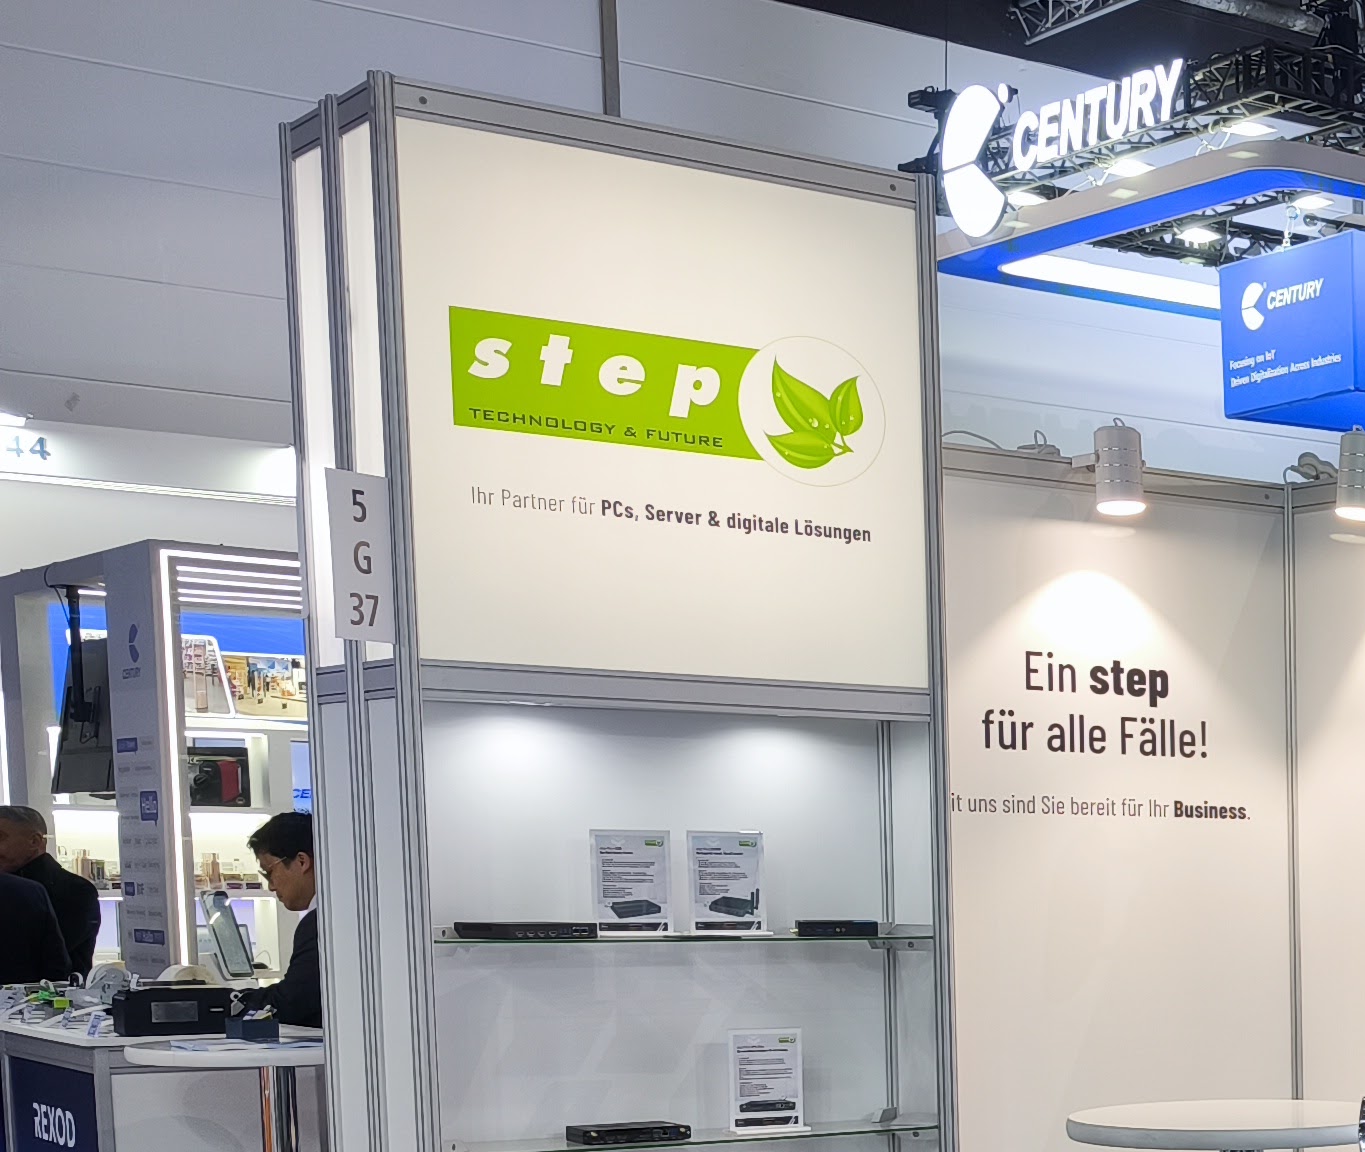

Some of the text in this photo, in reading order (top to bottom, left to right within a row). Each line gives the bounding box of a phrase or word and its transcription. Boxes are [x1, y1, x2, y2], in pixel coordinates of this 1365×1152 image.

[1013, 58, 1183, 172] CENTURY
[1267, 278, 1324, 311] CENTURY
[467, 333, 721, 419] step
[469, 407, 723, 448] TECHNOLOGY & FUTURE
[351, 490, 367, 523] 5
[471, 486, 871, 545] Ihr Partner für PCs, Server & digitale Lösungen
[353, 541, 372, 575] G
[349, 593, 379, 627] 37
[1025, 650, 1169, 707] Ein step
[982, 709, 1208, 758] für alle Fälle!
[968, 797, 997, 813] uns
[1002, 795, 1036, 815] sind
[1041, 795, 1065, 815] Sie
[1071, 797, 1116, 816] bereit
[1121, 798, 1143, 817] für
[1149, 799, 1169, 818] Ihr
[1174, 801, 1251, 820] Business.
[33, 1102, 75, 1148] REXOD
